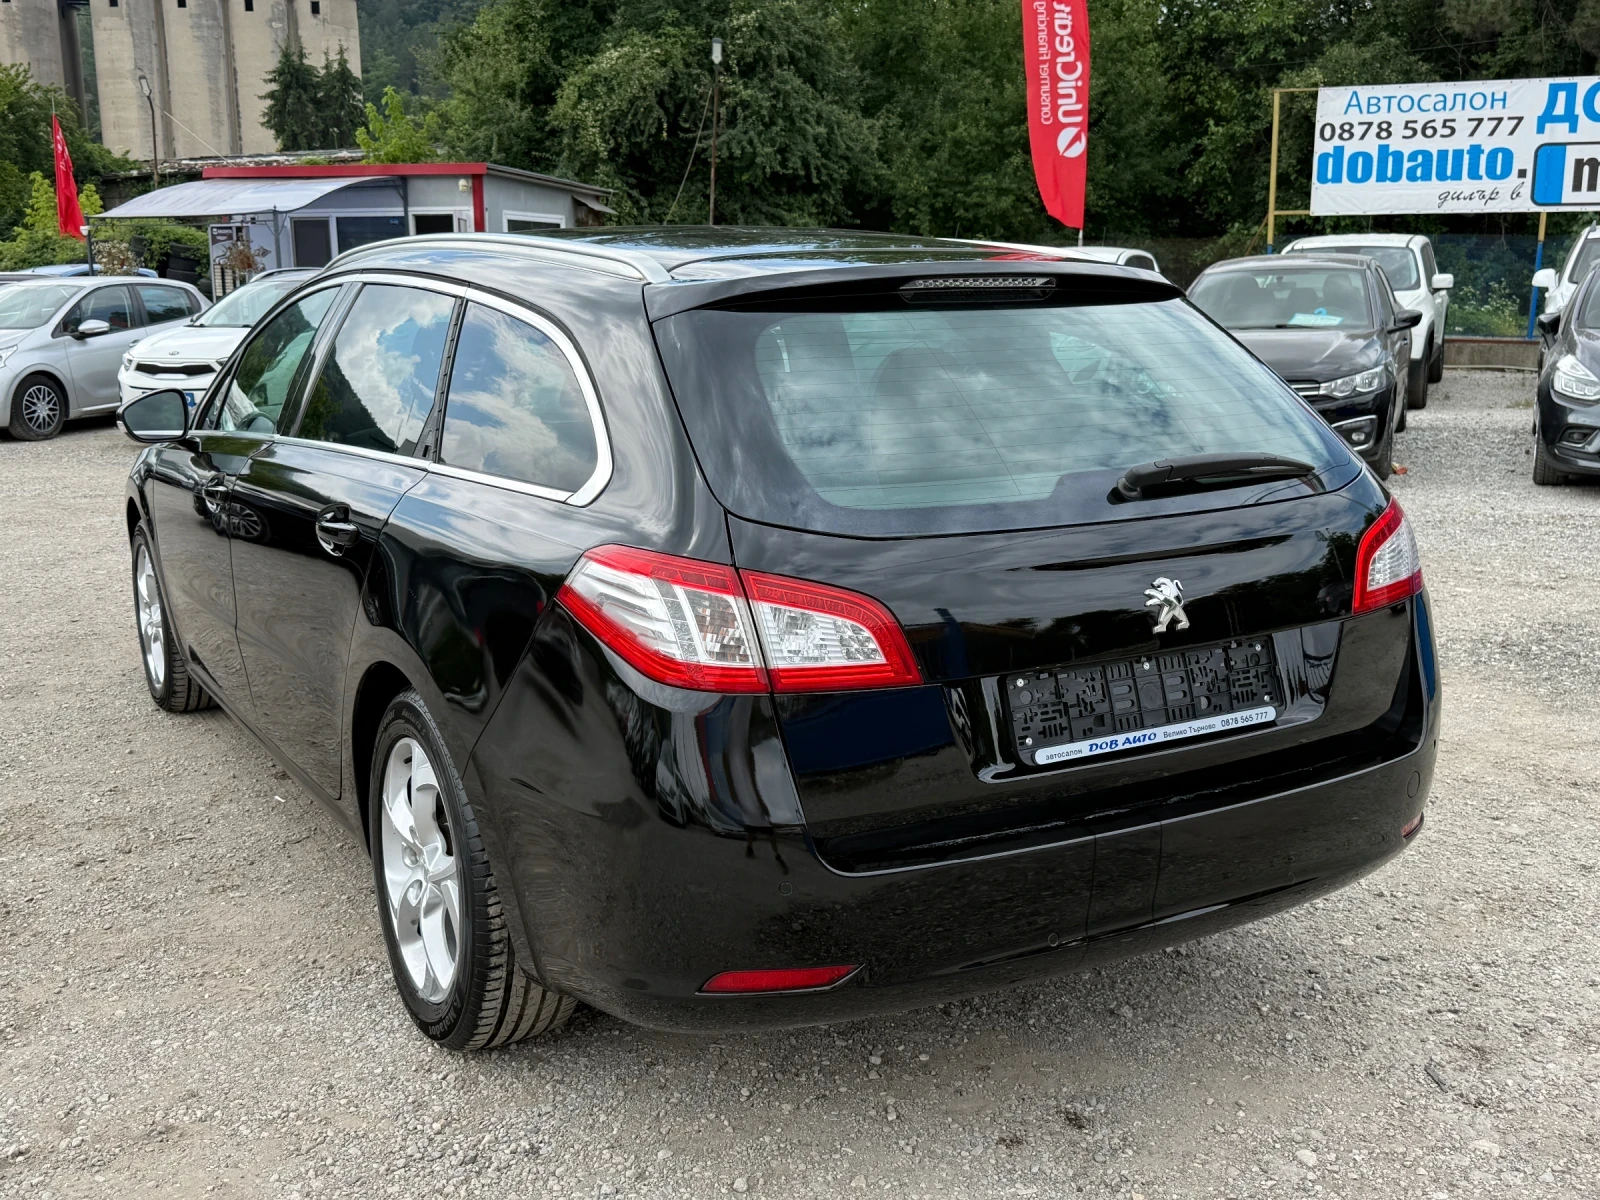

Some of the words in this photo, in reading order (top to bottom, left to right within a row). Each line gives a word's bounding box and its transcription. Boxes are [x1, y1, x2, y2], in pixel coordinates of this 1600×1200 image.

[1343, 90, 1507, 115] Автосалон
[1319, 120, 1393, 142] 0878
[1402, 118, 1457, 139] 565
[1467, 116, 1524, 138] 777
[1437, 187, 1500, 208] дилър
[1045, 748, 1083, 761] автосалон
[1088, 739, 1119, 752] DOB
[1122, 732, 1157, 746] AUTO
[1163, 728, 1188, 739] Велико
[1188, 723, 1216, 733] Търново
[1220, 716, 1239, 728] 0878
[1240, 714, 1254, 724] 565
[1255, 711, 1268, 721] 777
[429, 1007, 457, 1038] Matador
